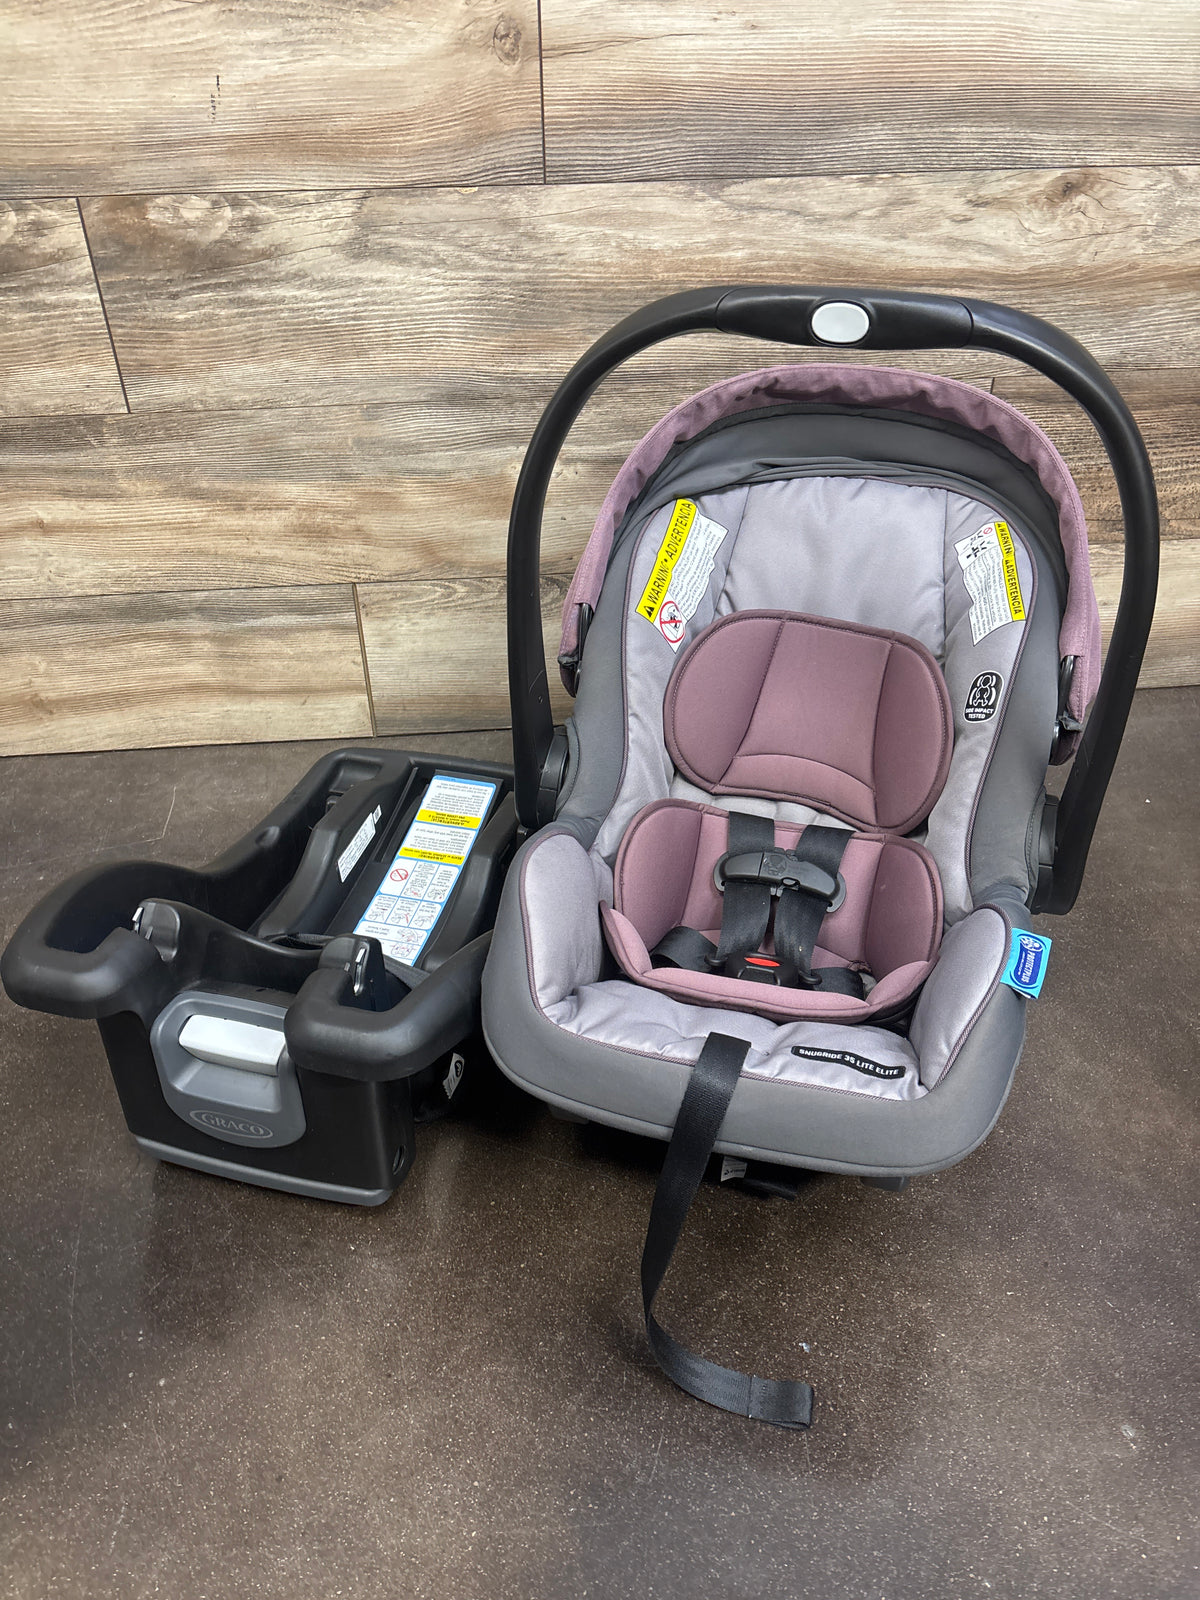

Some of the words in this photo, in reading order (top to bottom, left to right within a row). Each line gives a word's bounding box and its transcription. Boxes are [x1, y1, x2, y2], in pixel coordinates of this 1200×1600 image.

[999, 526, 1013, 555] WARNIN
[1005, 564, 1023, 615] ADVERTENCIA
[799, 1048, 843, 1060] SNUGRIDE
[844, 1054, 856, 1065] 35
[856, 1060, 875, 1071] LITE
[875, 1066, 899, 1076] ELITE
[201, 1113, 264, 1135] GRACO
